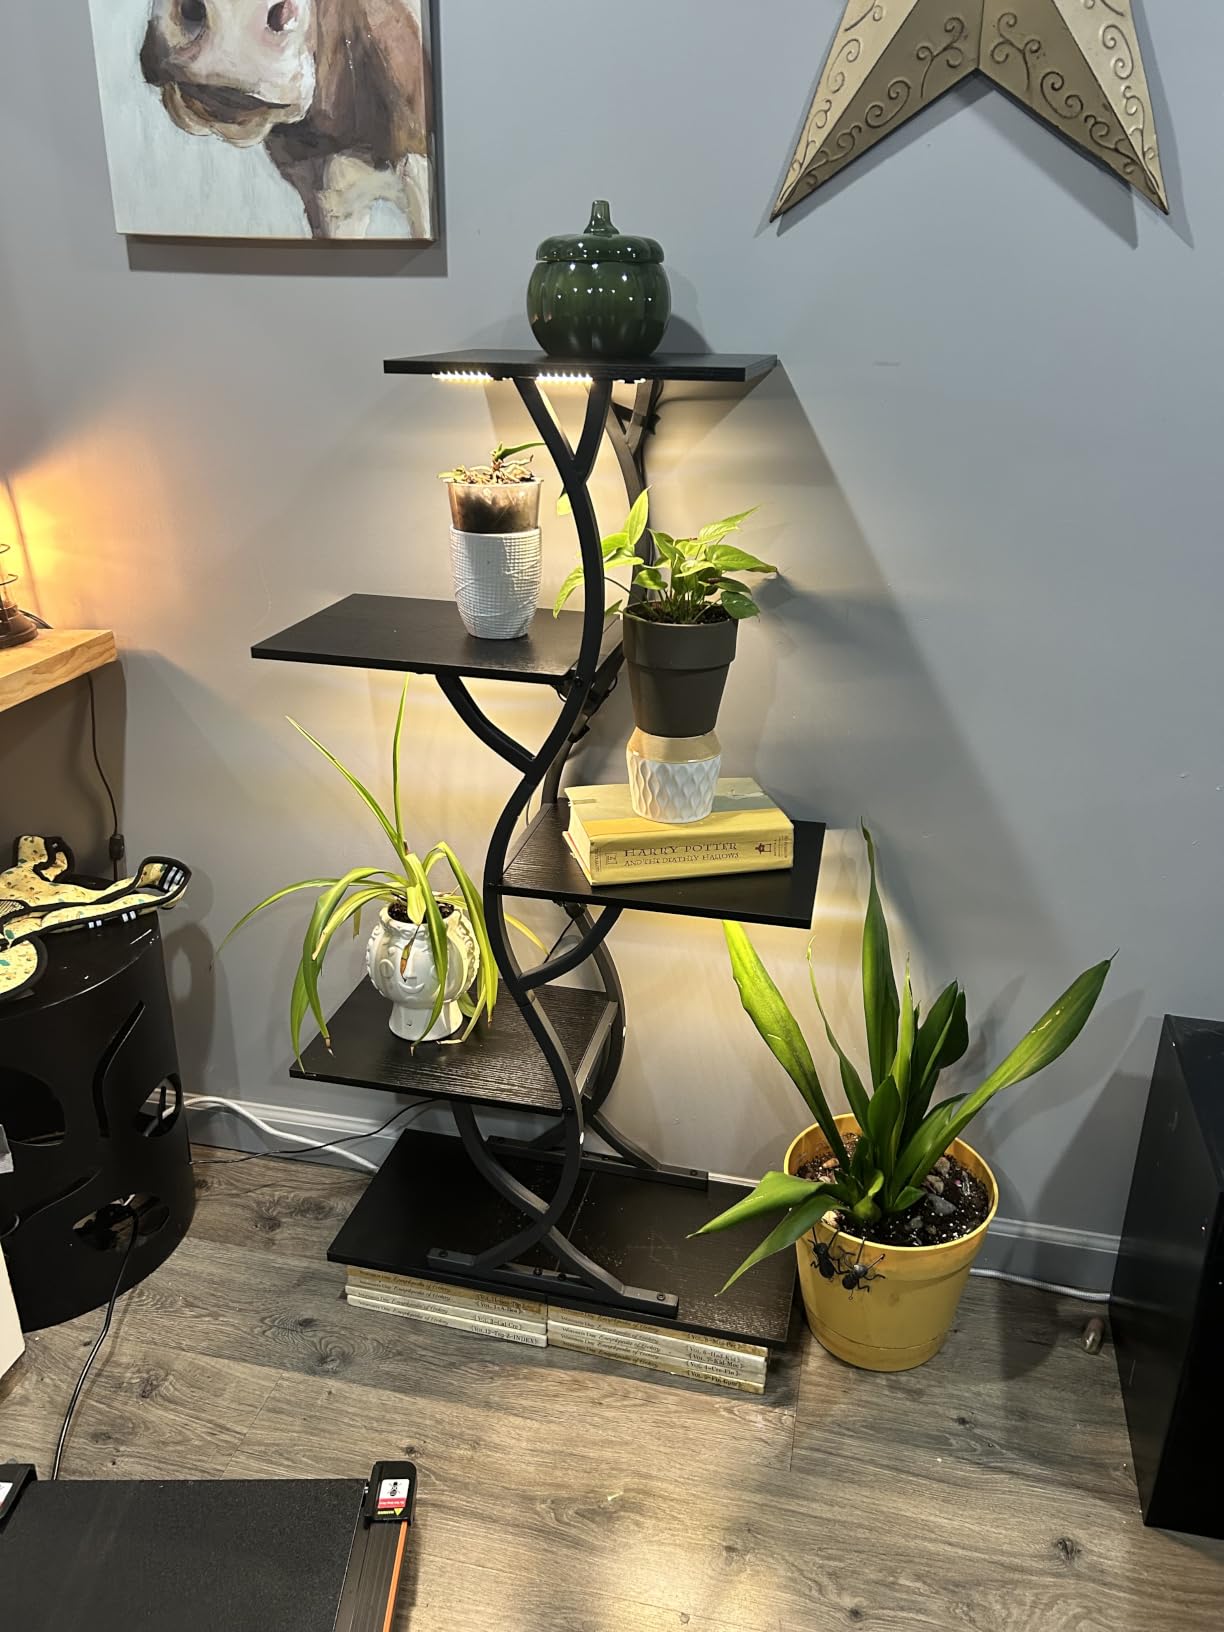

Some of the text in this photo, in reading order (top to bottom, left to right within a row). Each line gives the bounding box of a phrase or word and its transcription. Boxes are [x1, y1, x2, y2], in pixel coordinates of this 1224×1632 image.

[623, 842, 737, 857] HARRY POTTER
[624, 852, 739, 867] AND THE DEATHLY HALLOWS
